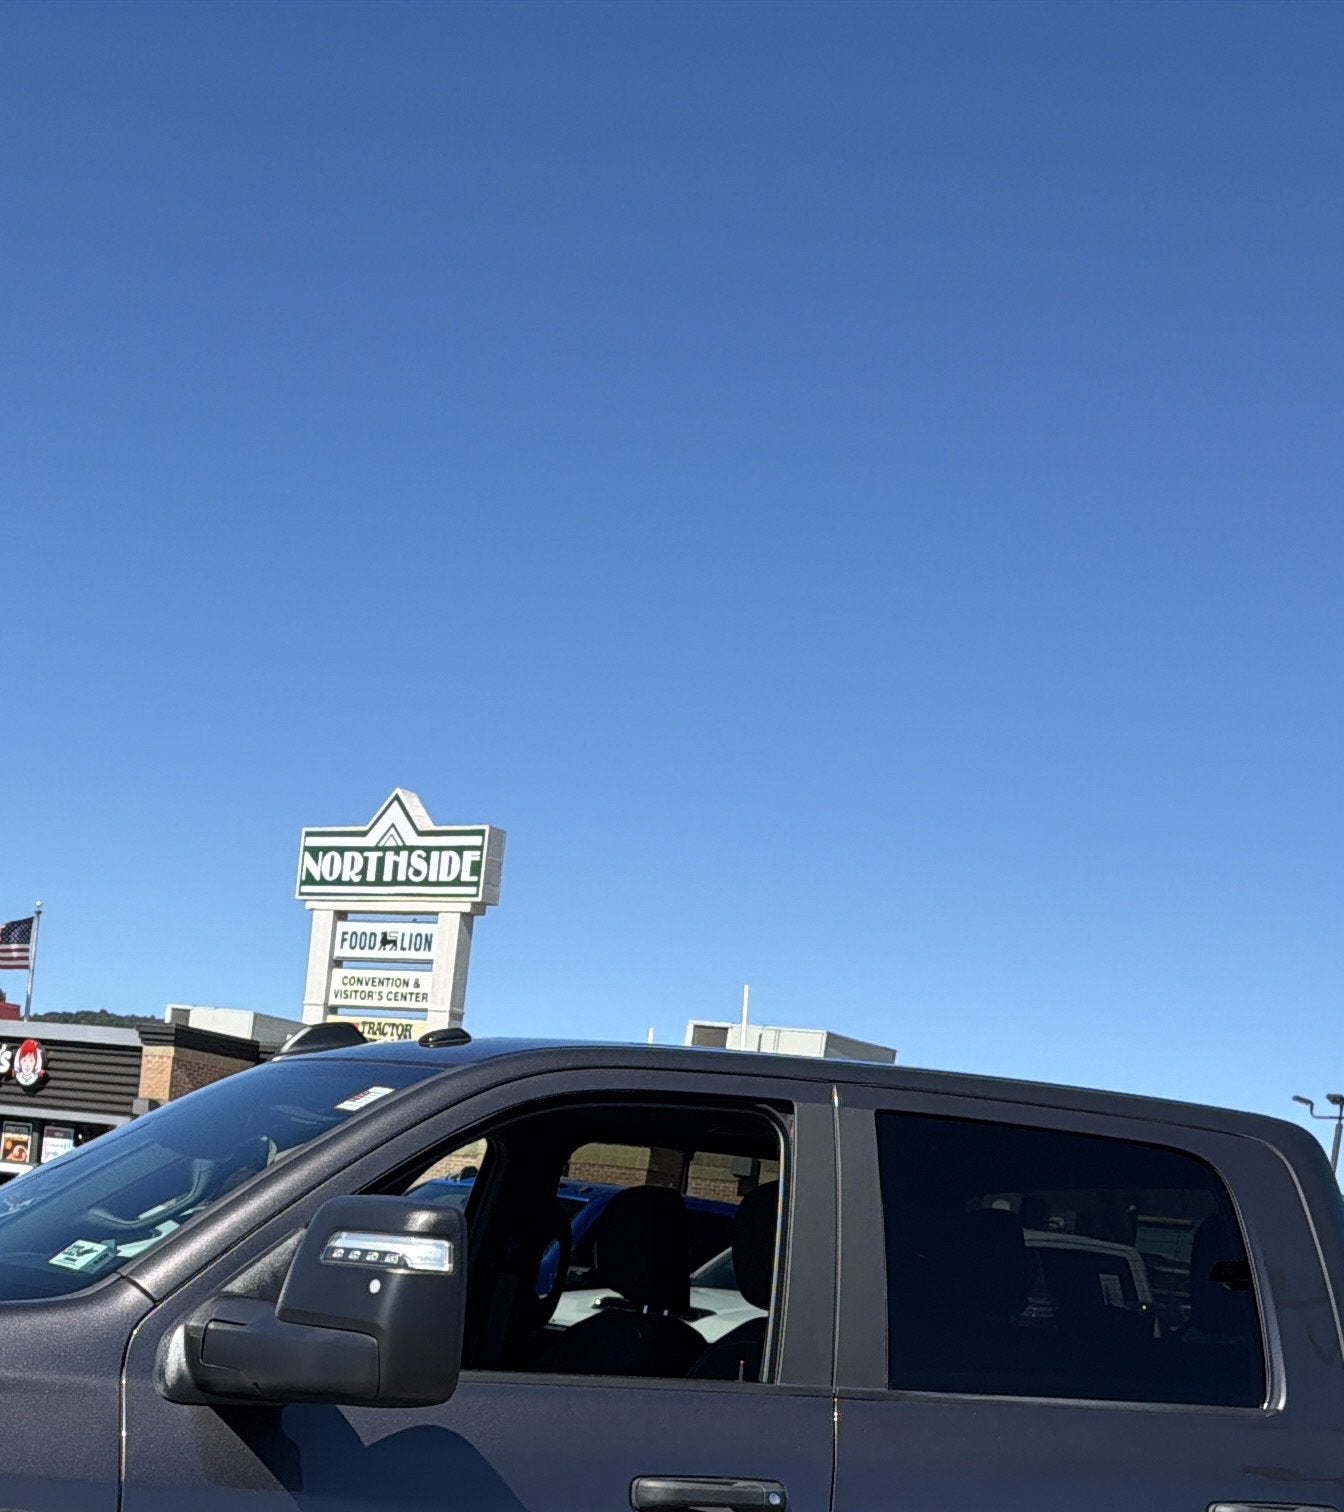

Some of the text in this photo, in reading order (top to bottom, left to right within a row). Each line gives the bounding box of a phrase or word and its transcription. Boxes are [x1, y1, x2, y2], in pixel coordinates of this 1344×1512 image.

[301, 850, 481, 883] NORTHSIDE
[339, 931, 433, 953] FOOD LION
[341, 976, 421, 989] CONVENTION &
[333, 990, 429, 1003] VISITOR'S CENTER
[360, 1021, 413, 1039] TRACTOR
